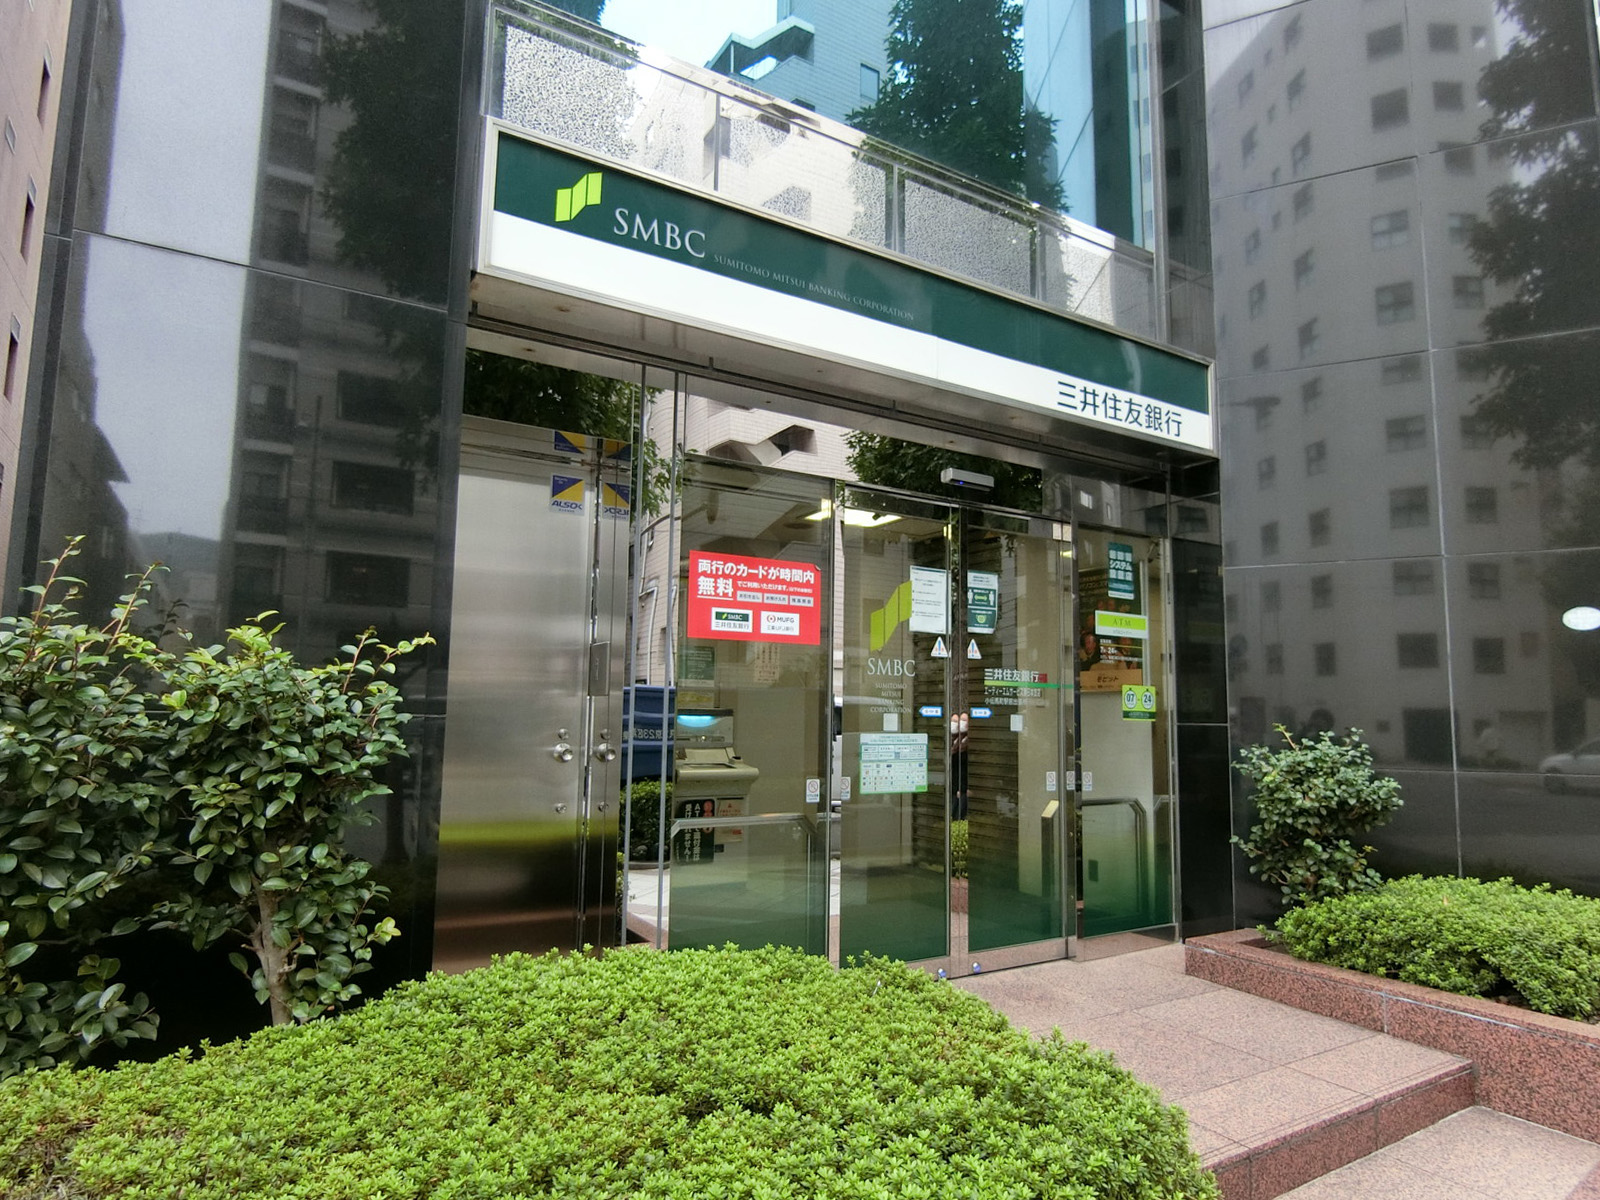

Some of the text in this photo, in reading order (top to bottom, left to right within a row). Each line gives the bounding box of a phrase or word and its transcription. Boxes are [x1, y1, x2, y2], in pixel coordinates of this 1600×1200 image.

[613, 207, 706, 258] SMBC
[713, 253, 914, 321] SUMITOMO MITSUI BANKING CORPORATION
[1057, 380, 1183, 437] 三井住友銀行
[697, 558, 815, 584] 両行のカードが時間内
[697, 575, 734, 597] 無料
[777, 616, 795, 624] MUFG
[1112, 617, 1132, 627] ATM
[867, 657, 916, 677] SMBC
[984, 668, 1040, 683] 三井住友銀行
[1126, 693, 1135, 702] 07
[1143, 694, 1152, 703] 24
